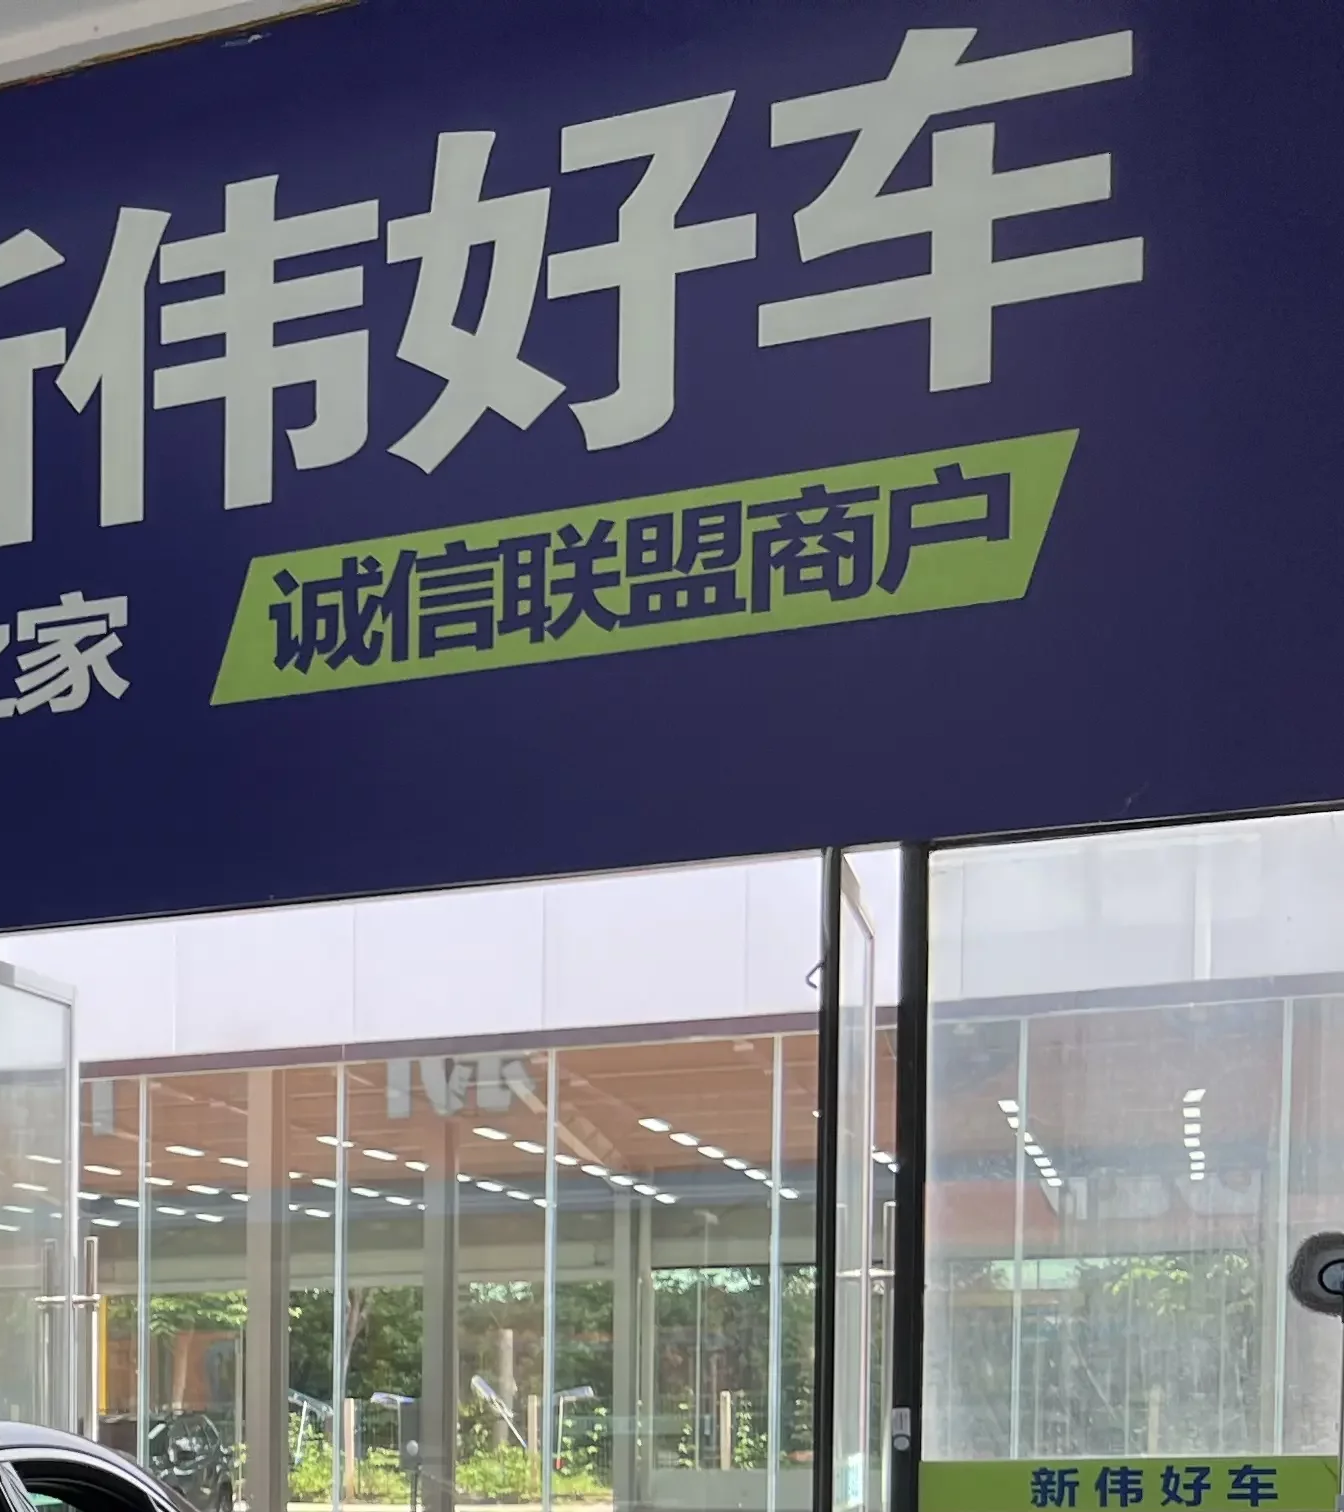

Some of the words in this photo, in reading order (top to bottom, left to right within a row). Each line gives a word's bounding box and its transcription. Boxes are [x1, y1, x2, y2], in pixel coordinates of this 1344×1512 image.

[267, 462, 1012, 677] 诚信联盟商户
[1029, 1463, 1279, 1509] 新伟好车
